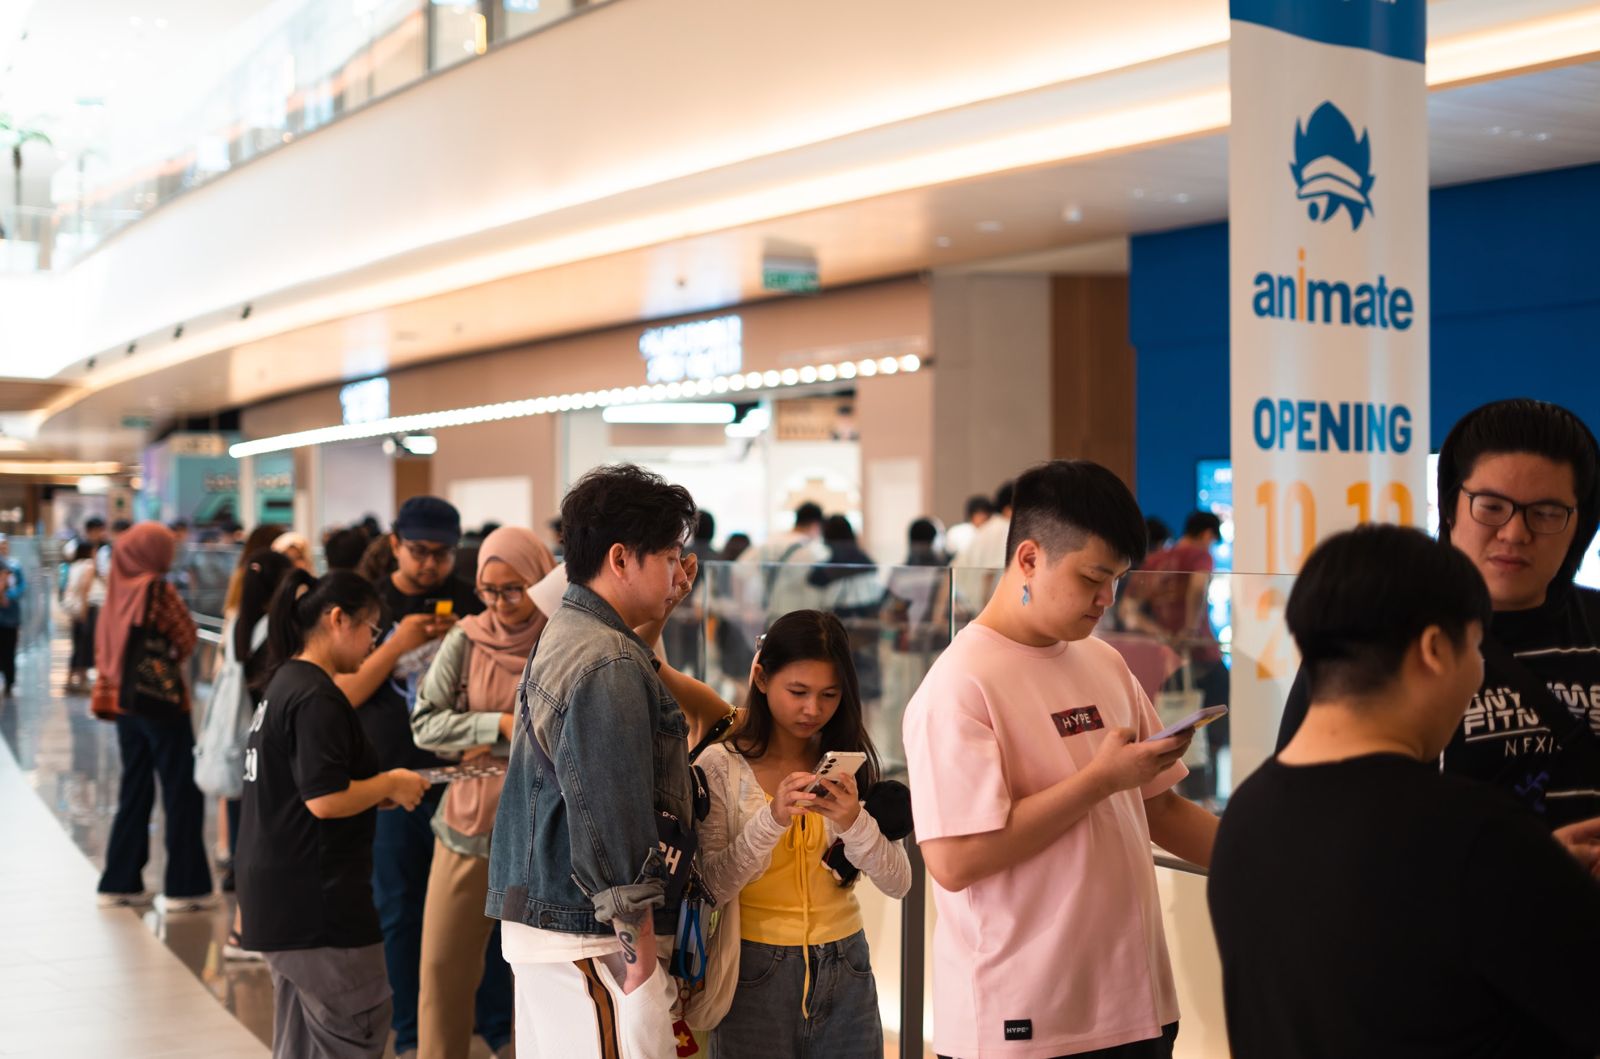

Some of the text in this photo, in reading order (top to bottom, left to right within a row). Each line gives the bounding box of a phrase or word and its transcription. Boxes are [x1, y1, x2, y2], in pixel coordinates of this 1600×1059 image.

[1252, 247, 1414, 331] animate
[1253, 397, 1413, 454] OPENING
[1062, 713, 1091, 729] HYPE
